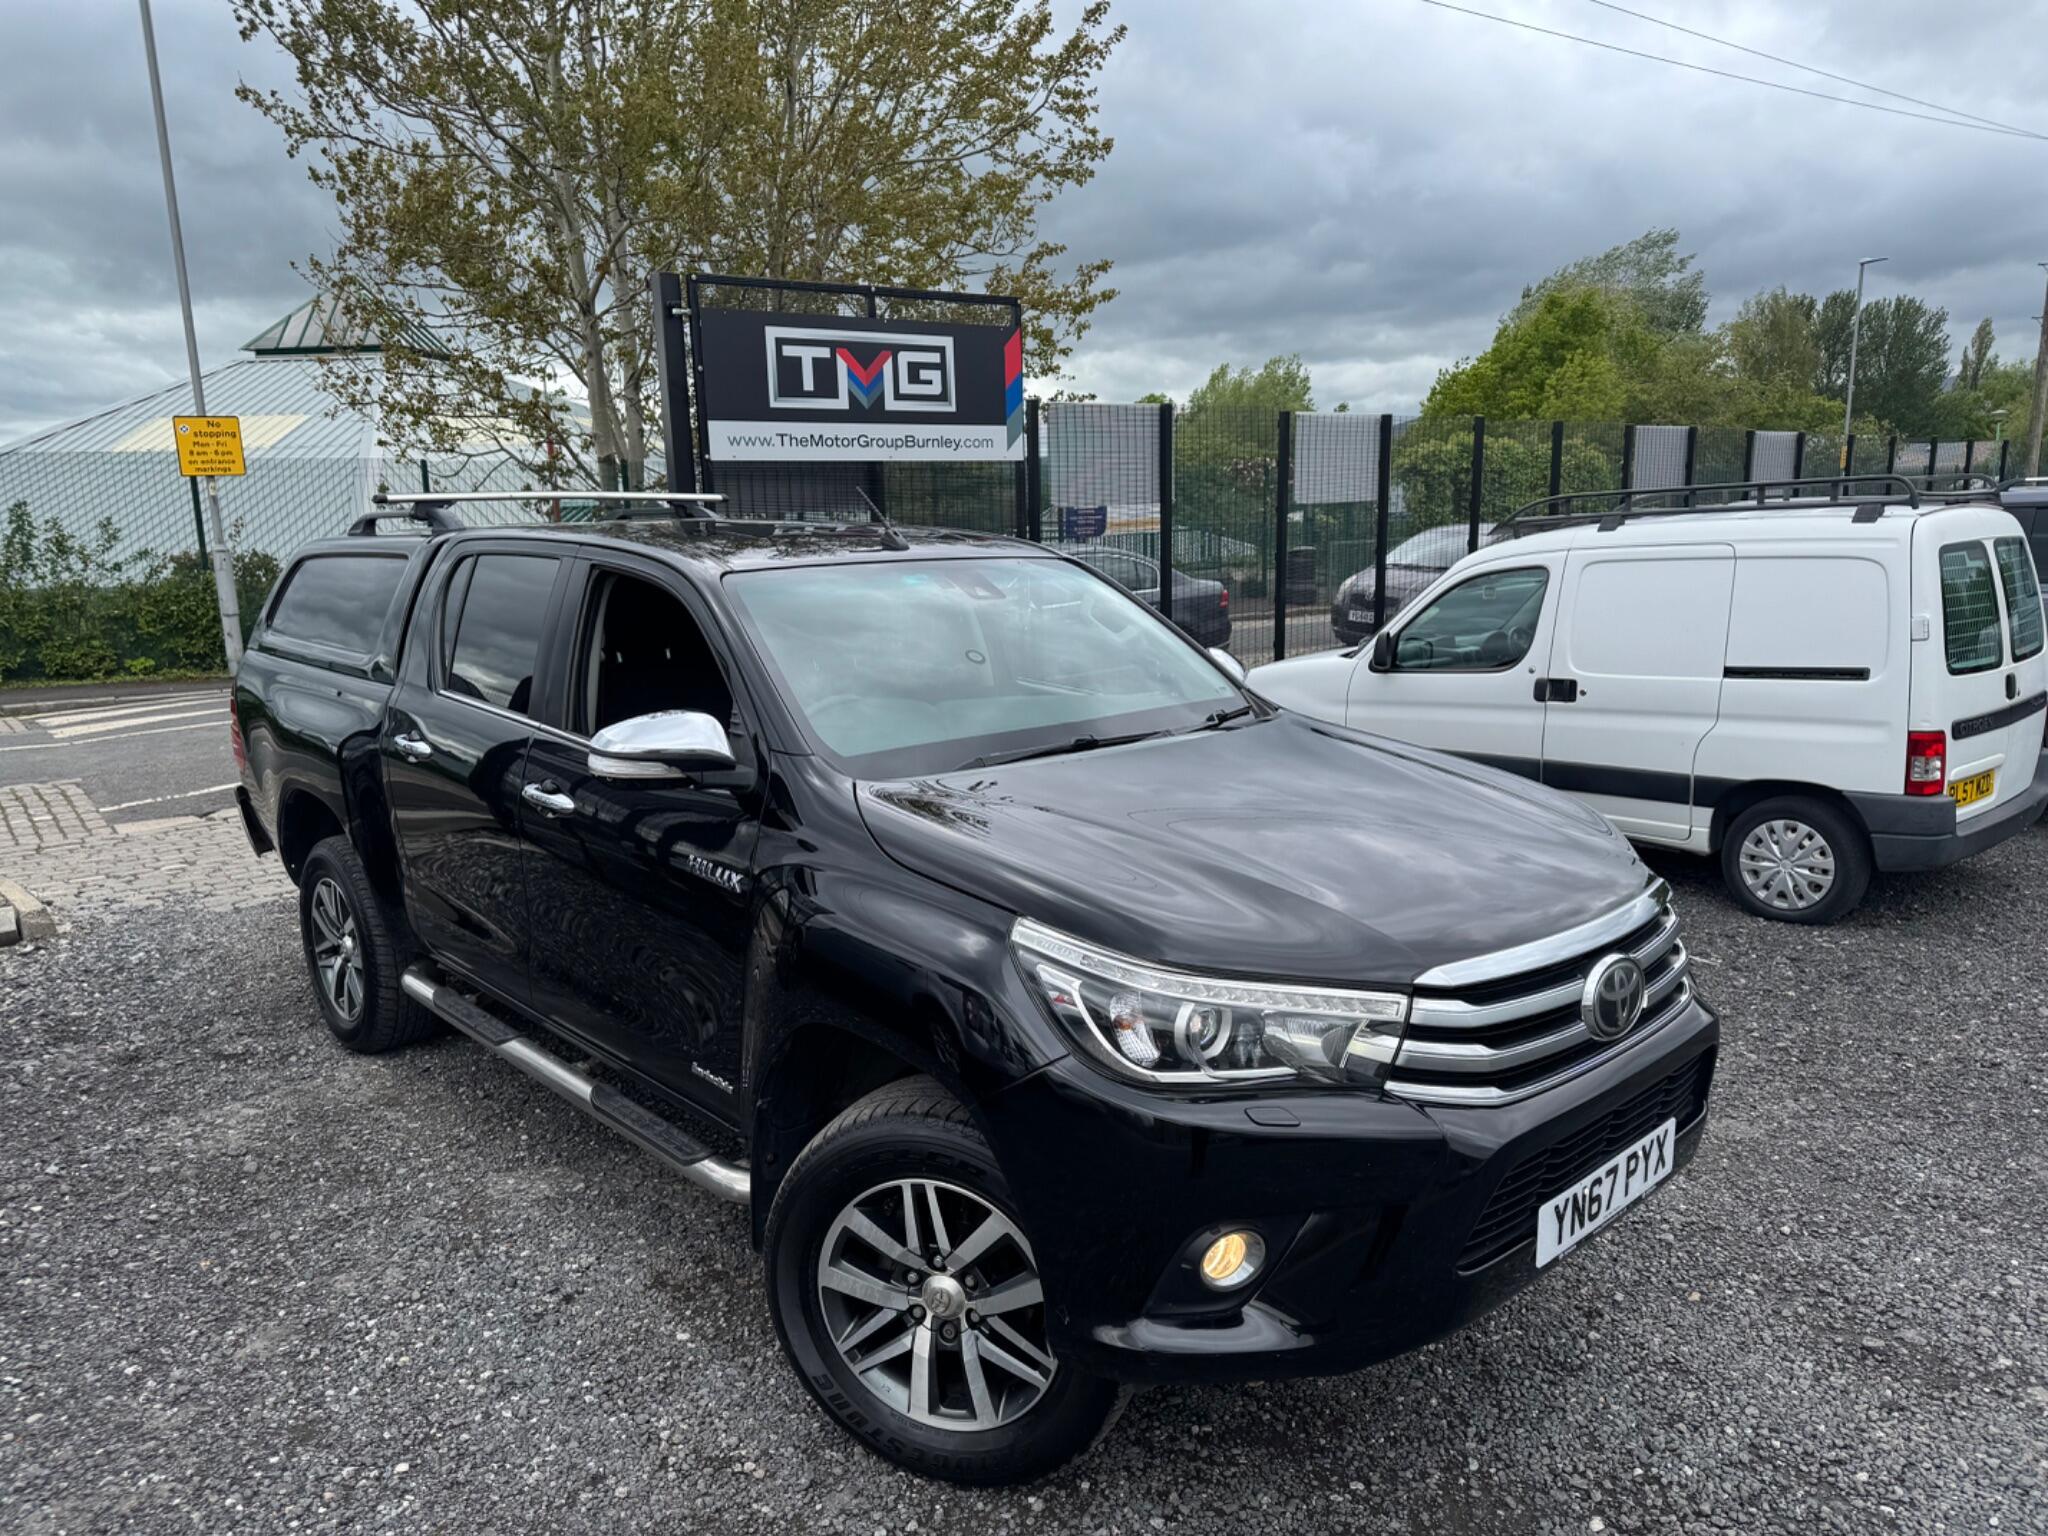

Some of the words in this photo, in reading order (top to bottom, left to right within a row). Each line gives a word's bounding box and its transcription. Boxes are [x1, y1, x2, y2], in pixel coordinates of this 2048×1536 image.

[781, 343, 942, 410] TMG
[207, 420, 221, 428] No
[193, 430, 237, 438] stopping
[727, 432, 994, 450] www.TheMotorGroupBurnley.com
[1554, 1164, 1619, 1246] YN67
[1624, 1129, 1669, 1198] PYX
